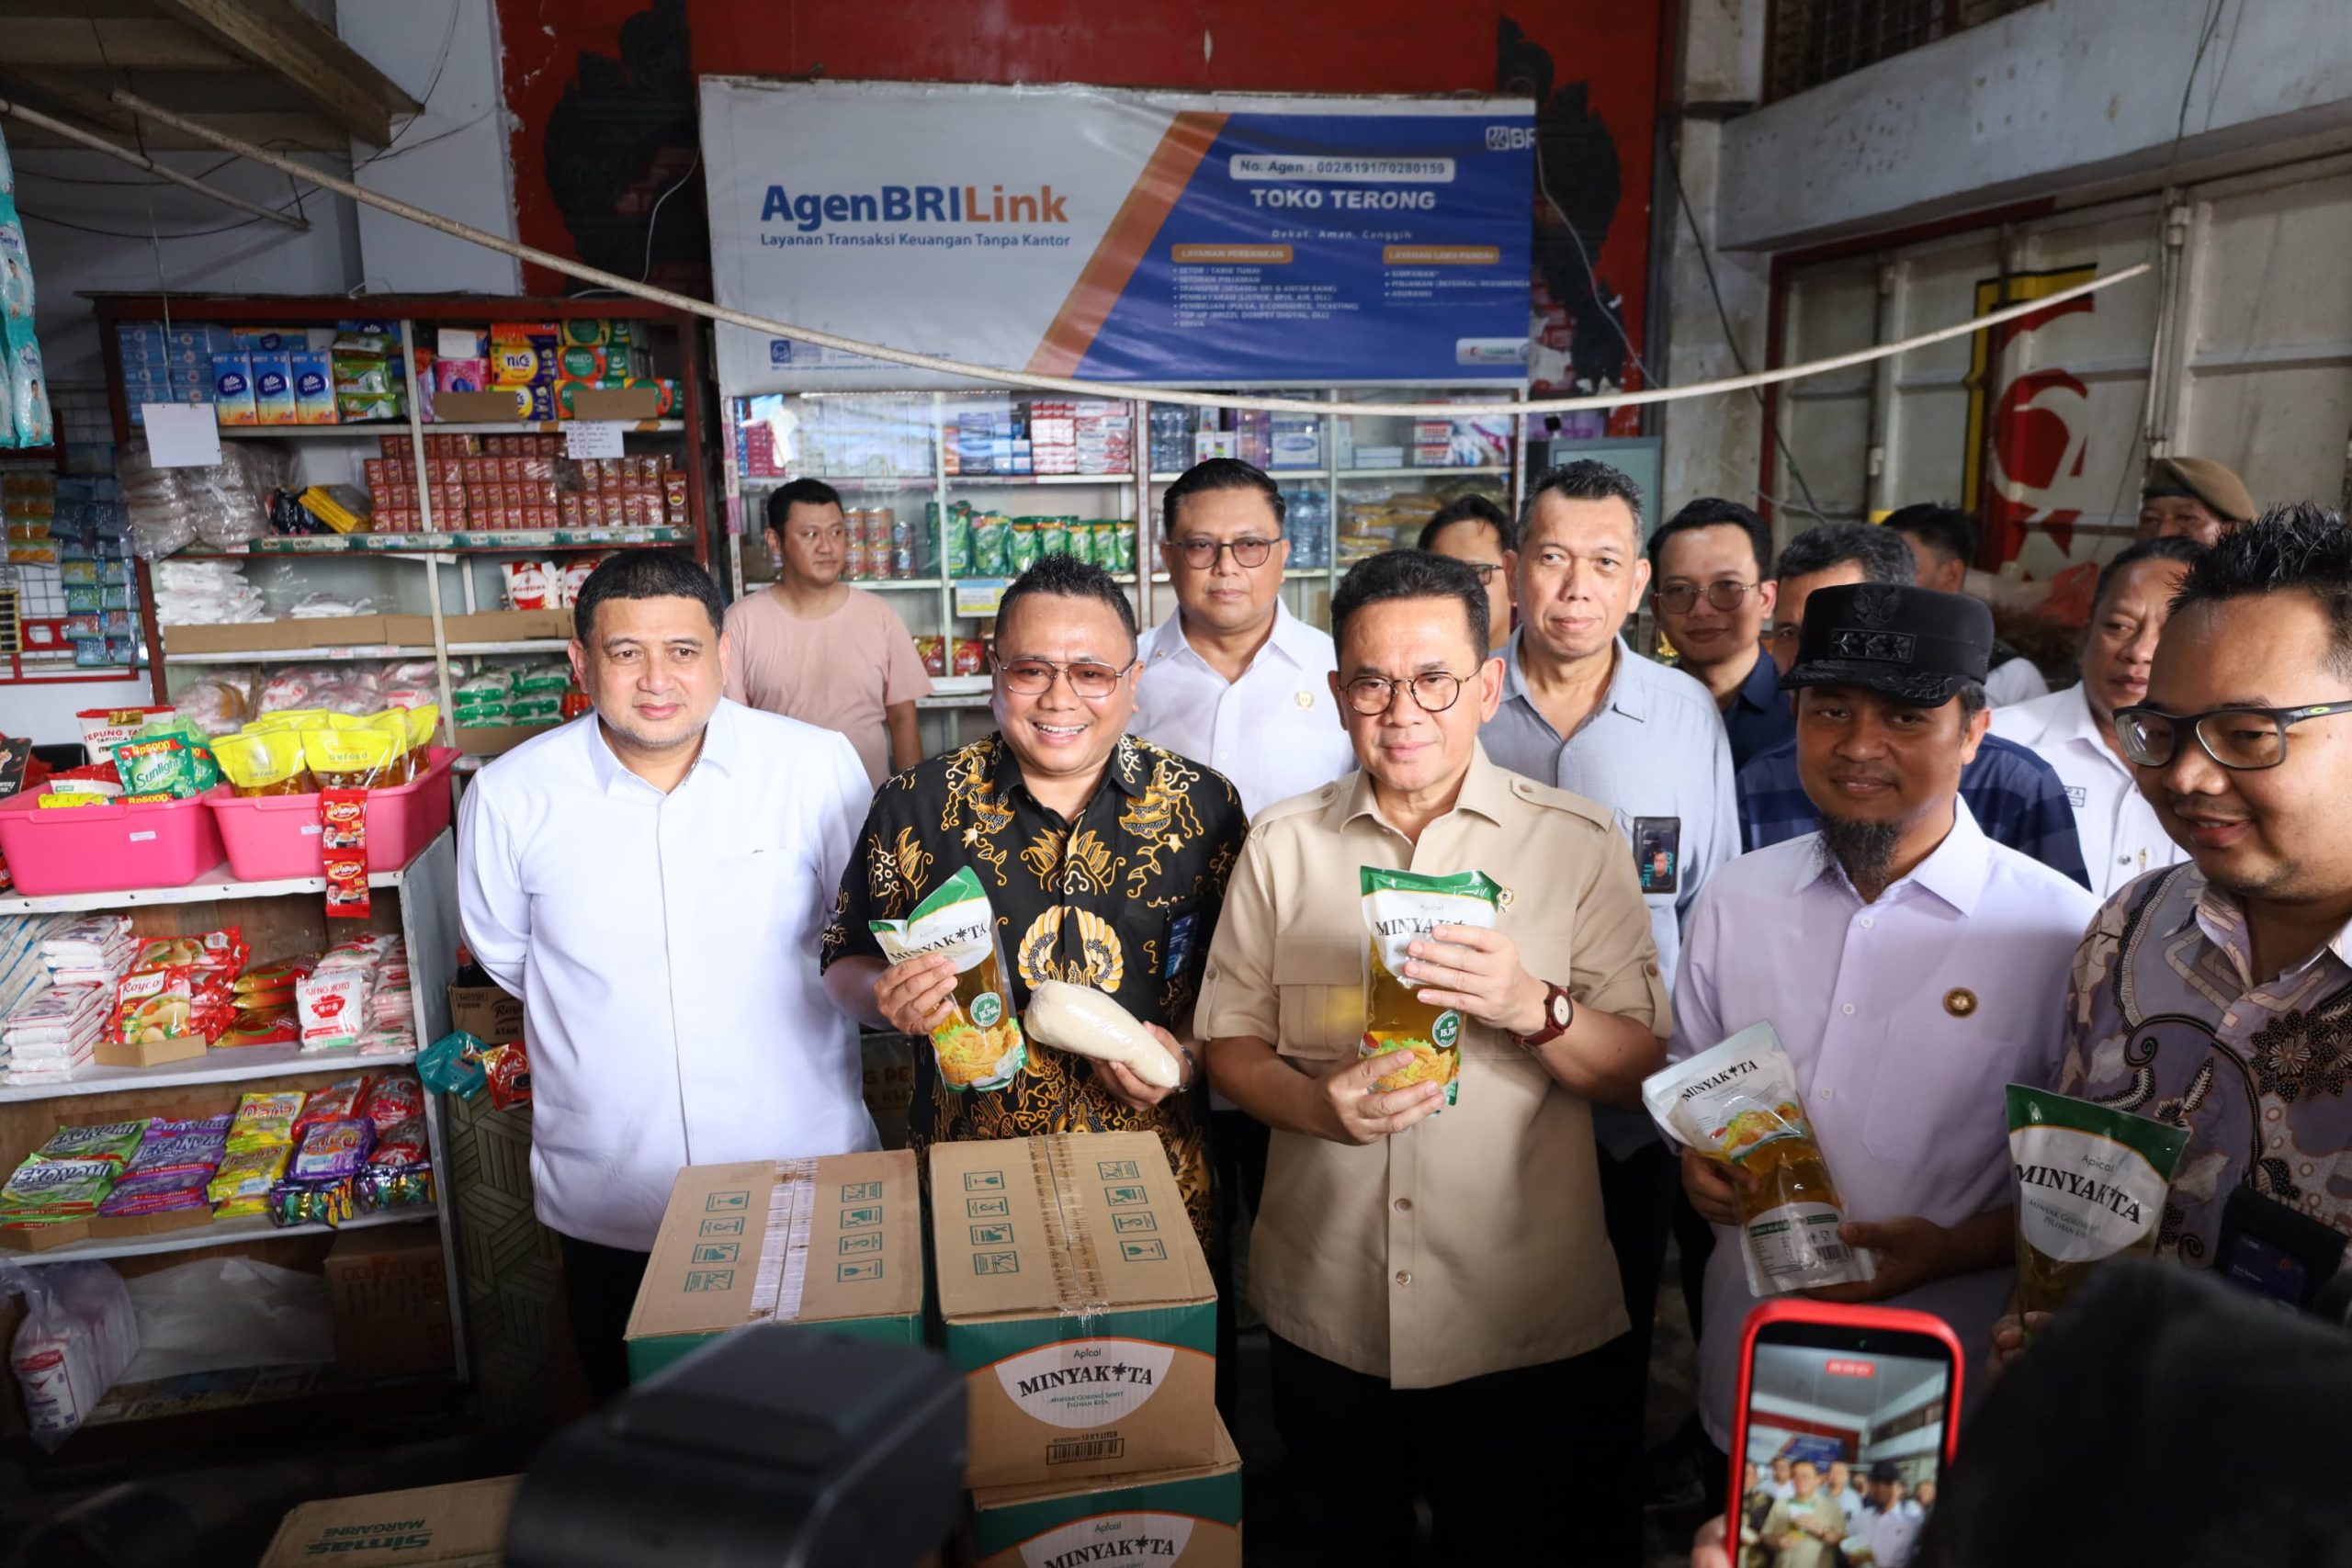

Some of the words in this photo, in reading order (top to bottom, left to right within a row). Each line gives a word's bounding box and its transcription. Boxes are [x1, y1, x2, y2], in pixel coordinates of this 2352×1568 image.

[1240, 160, 1263, 173] No.
[1268, 161, 1304, 175] Agen
[1250, 189, 1322, 209] TOKO
[1330, 190, 1436, 209] TERONG
[761, 186, 1069, 232] AgenBRILink
[761, 233, 823, 249] Layanan
[826, 233, 895, 247] Transaksi
[899, 234, 972, 249] Keuangan
[975, 234, 1019, 249] Tanpa
[1023, 234, 1070, 247] Kantor
[1363, 230, 1413, 242] Canggih
[1182, 249, 1226, 258] LAYANAN
[1227, 249, 1283, 258] PERBANKAN
[1389, 251, 1432, 259] LAYANAN
[1179, 285, 1219, 293] TRANSFER
[1179, 302, 1226, 310] PEMBELIAN
[84, 728, 123, 742] TEPUNG
[131, 740, 172, 756] Rp5000
[136, 757, 180, 788] Sunlight
[123, 978, 161, 994] Royco
[2081, 1154, 2114, 1173] Apical
[13, 1164, 110, 1184] EKONOMI
[2029, 1200, 2059, 1218] MINYAK
[1073, 1348, 1102, 1359] Apical
[1050, 1395, 1076, 1404] MINYAK
[1067, 1401, 1092, 1409] PILIHAN
[324, 1520, 425, 1536] MARGARINE
[1094, 1520, 1122, 1533] Apical
